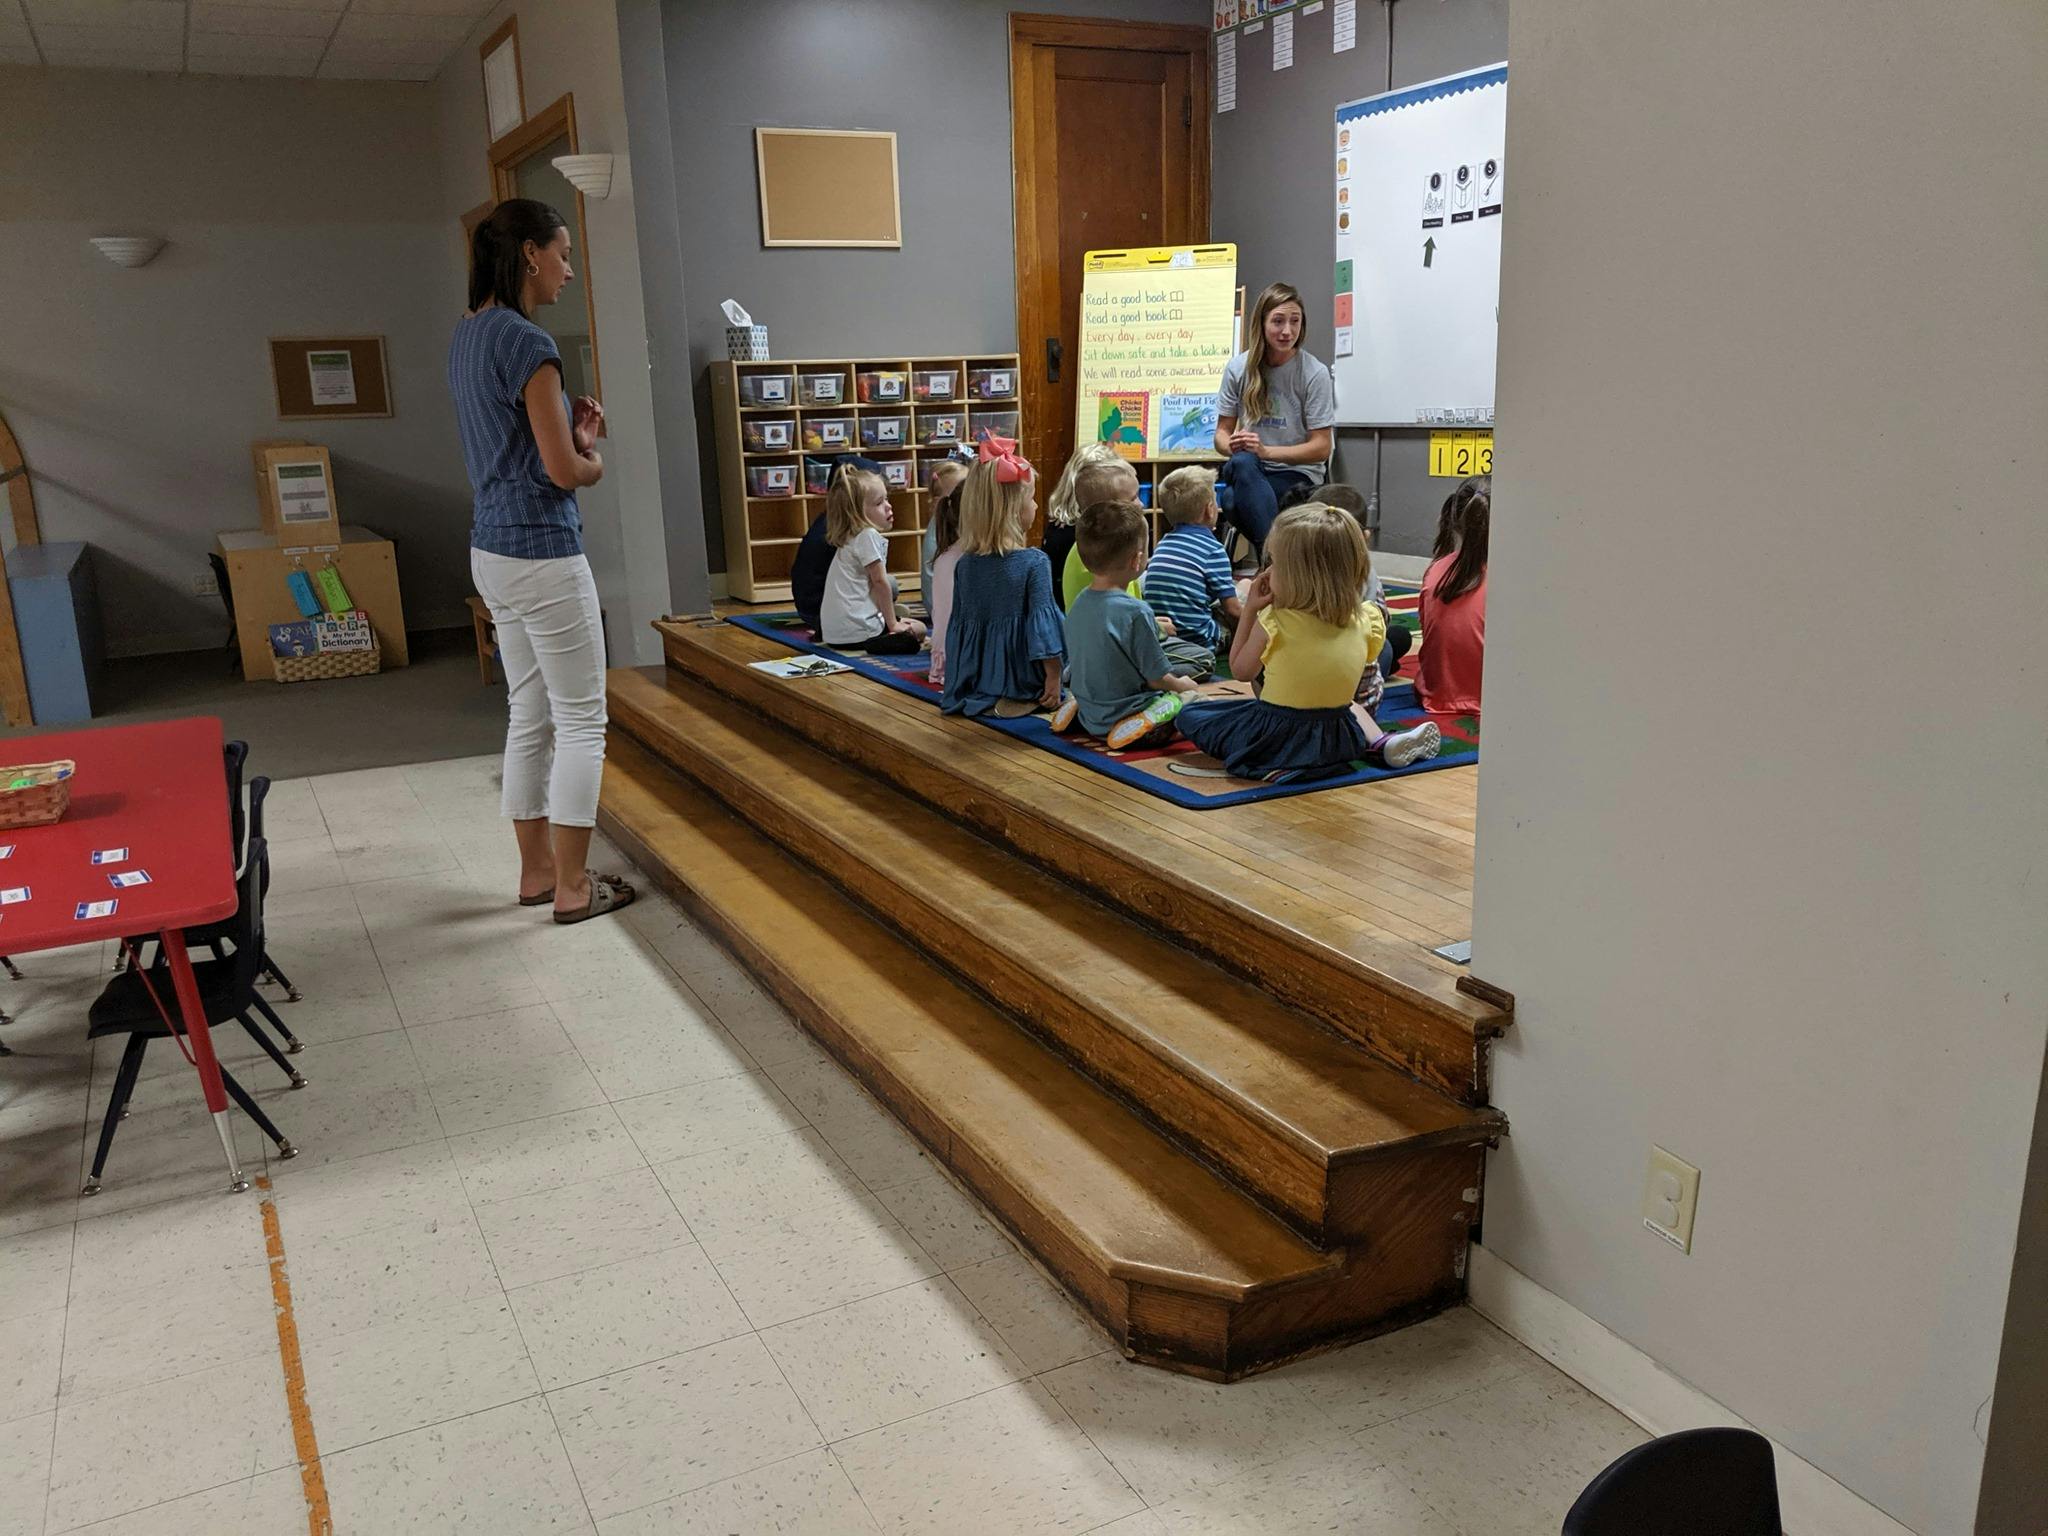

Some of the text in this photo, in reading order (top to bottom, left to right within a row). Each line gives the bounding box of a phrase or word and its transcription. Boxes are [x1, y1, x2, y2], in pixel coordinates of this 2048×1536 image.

[1086, 290, 1167, 308] Read a good book
[1086, 308, 1168, 326] Read a good book
[1086, 331, 1114, 344] Every
[1145, 331, 1172, 344] every
[1177, 328, 1194, 343] day
[1084, 344, 1217, 360] Sit down safe and take a look
[1084, 367, 1099, 379] We
[1101, 366, 1117, 379] will
[1120, 365, 1142, 379] read
[1146, 368, 1168, 377] some
[1170, 368, 1206, 377] awesome
[1457, 448, 1469, 475] 2
[1481, 448, 1493, 475] 3
[321, 638, 370, 648] Dictionary
